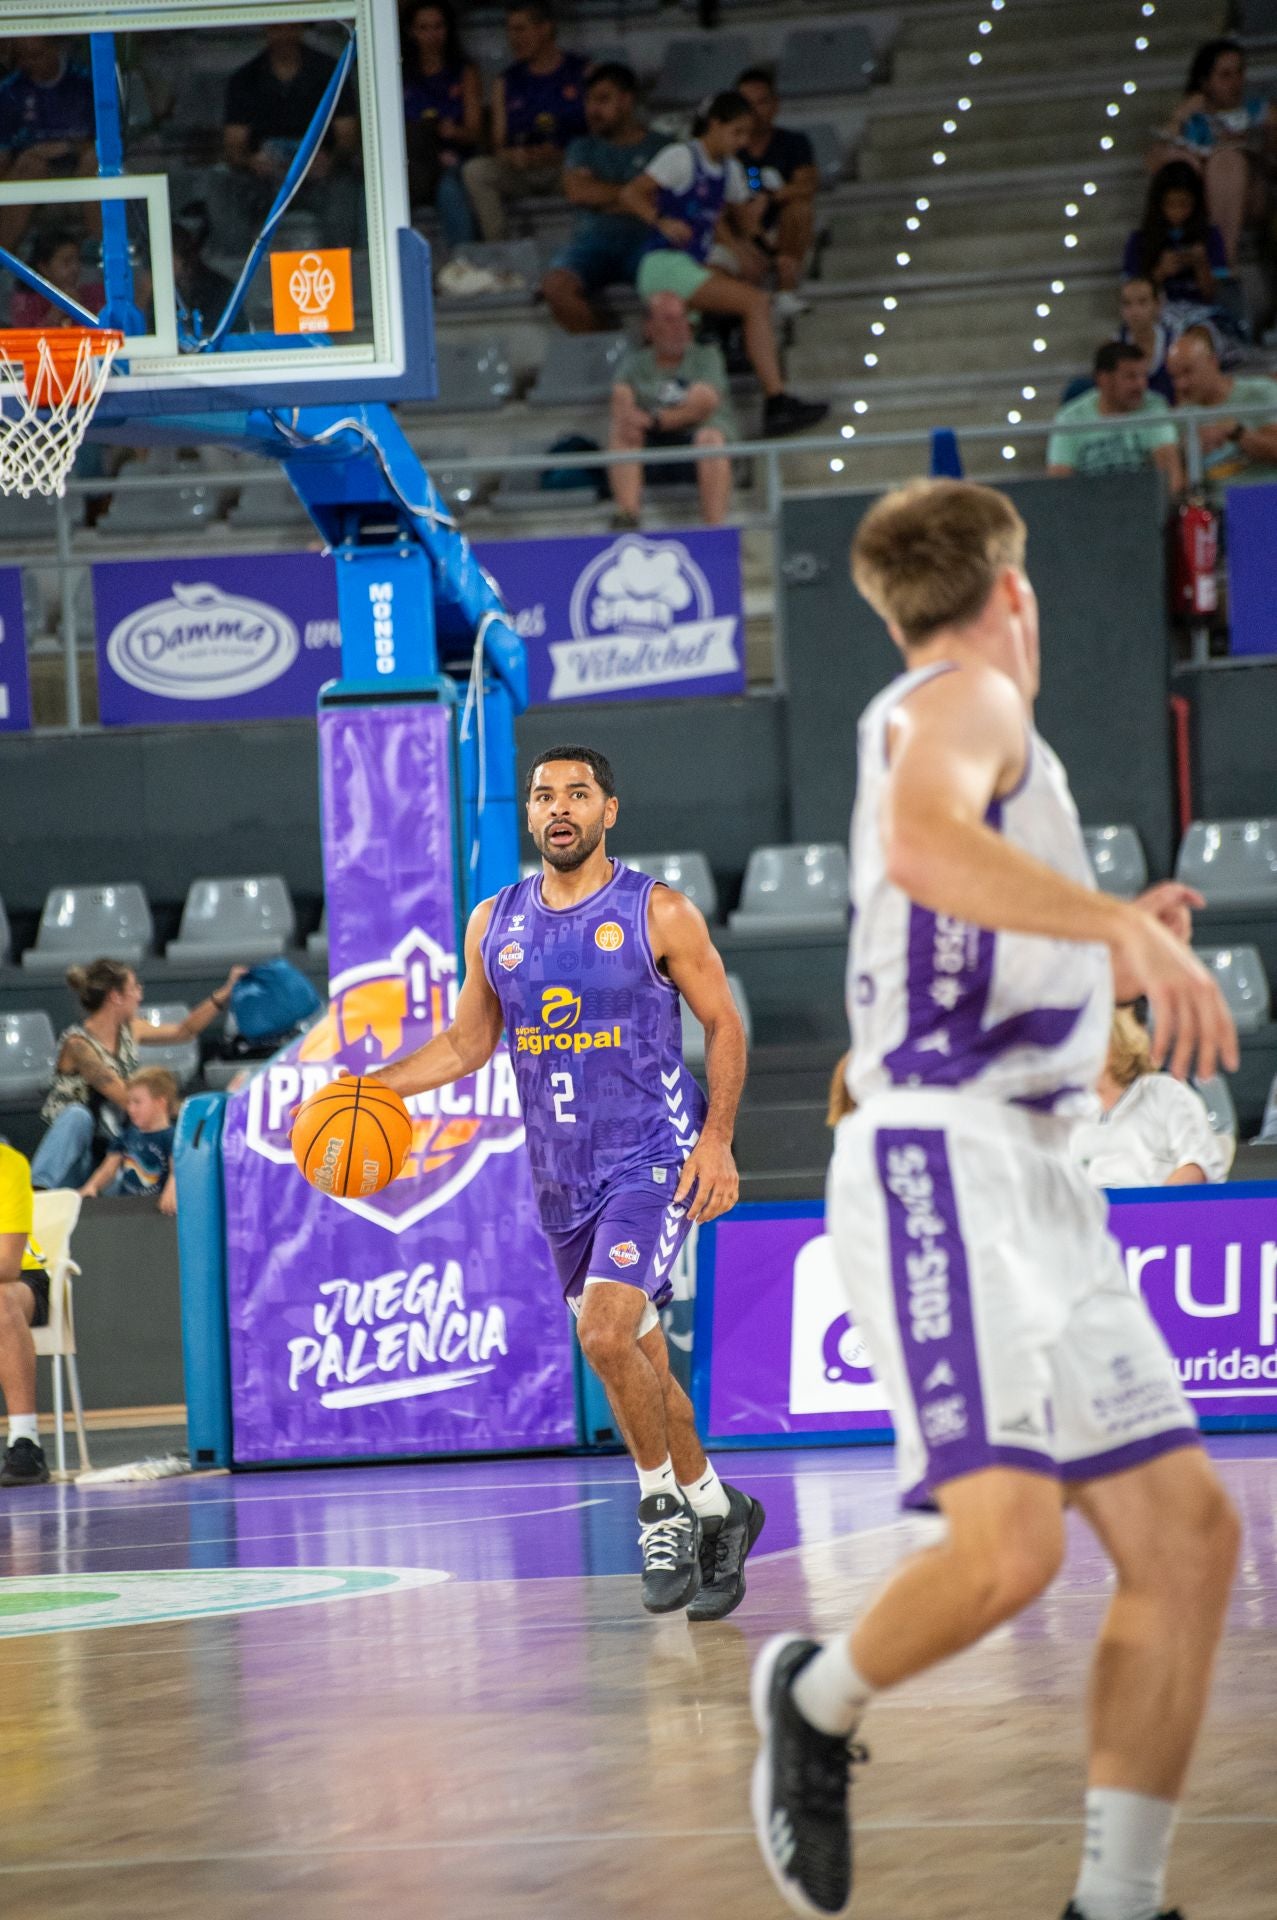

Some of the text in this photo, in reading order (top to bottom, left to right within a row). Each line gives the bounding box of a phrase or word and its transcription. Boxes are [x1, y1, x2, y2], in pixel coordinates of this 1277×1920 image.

[368, 581, 396, 675] MONDO
[517, 1025, 622, 1056] agropal
[550, 1071, 577, 1124] 2
[313, 1259, 467, 1336] JUEGA
[286, 1304, 509, 1392] PALENCIA
